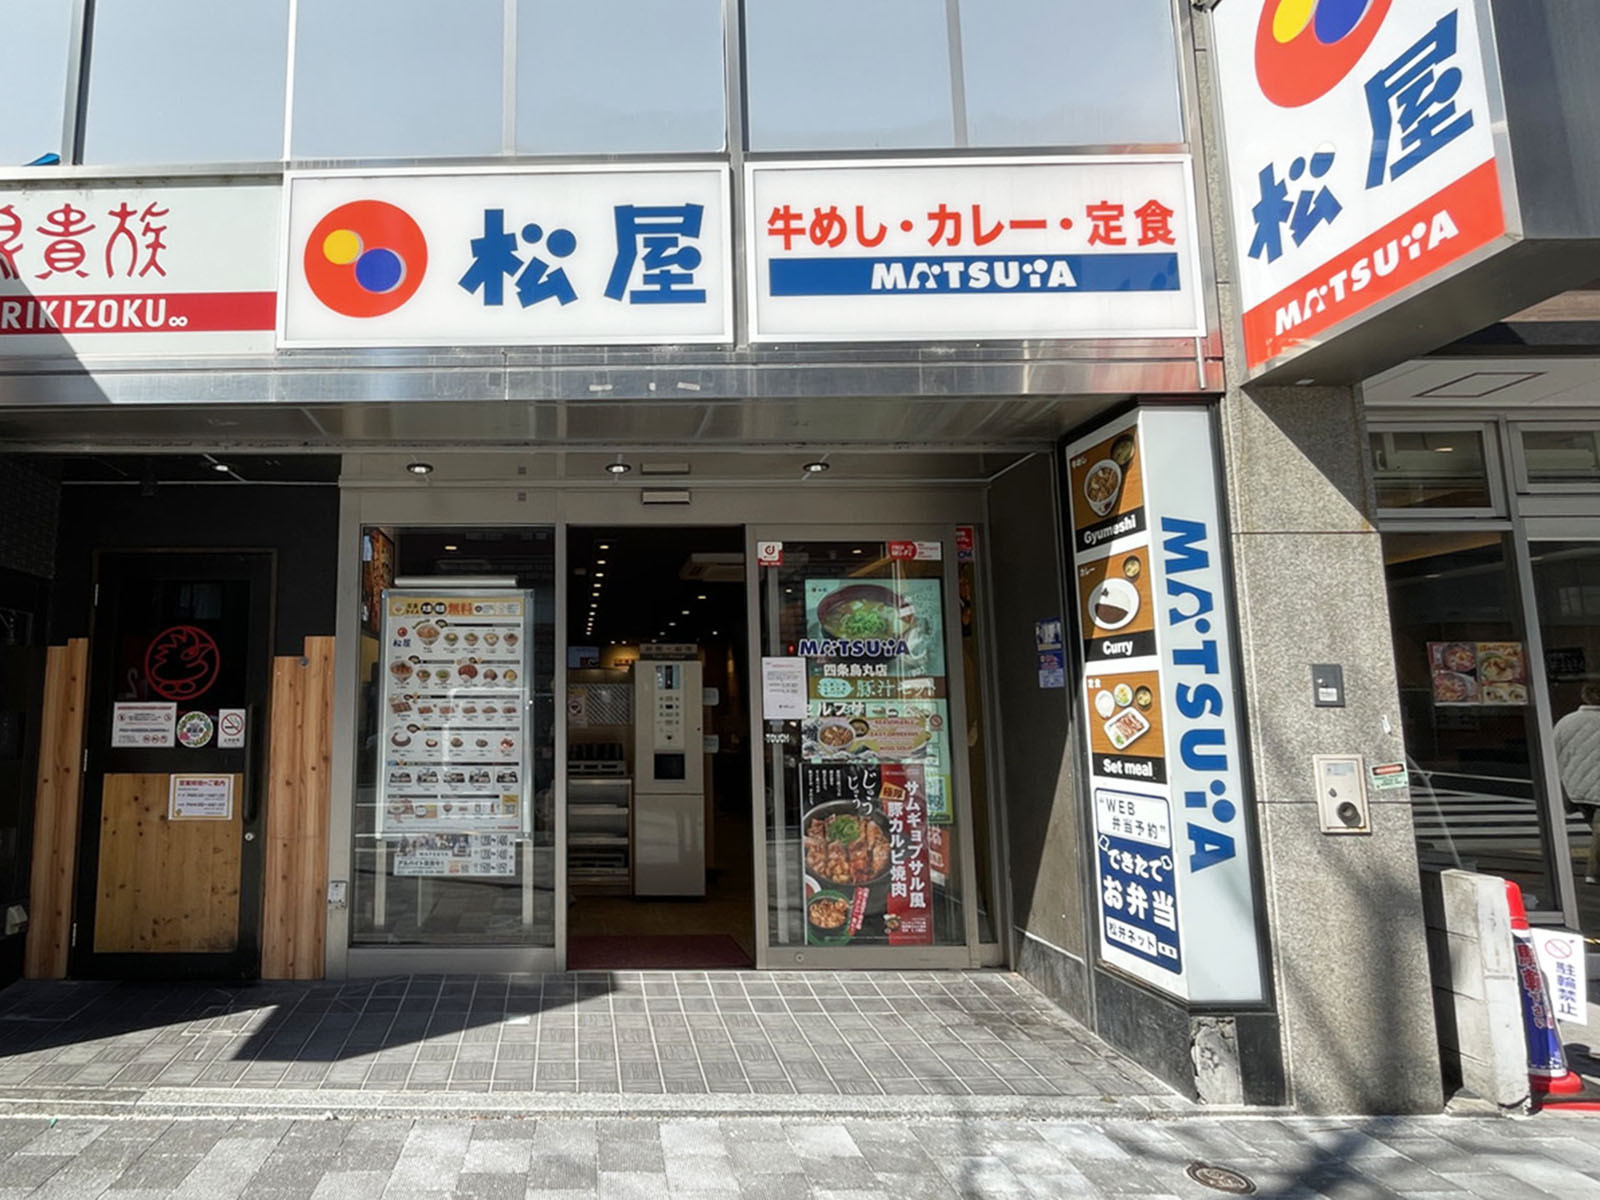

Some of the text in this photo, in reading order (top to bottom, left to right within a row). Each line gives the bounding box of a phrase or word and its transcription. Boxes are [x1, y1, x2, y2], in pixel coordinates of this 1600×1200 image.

[1247, 8, 1474, 264] 松屋
[767, 199, 1176, 250] 牛めし・カレー・定食
[458, 203, 706, 308] 松屋
[871, 258, 1077, 290] MATSUYA
[1274, 209, 1459, 337] MATSUYA
[1084, 514, 1136, 545] Gyumeshi
[798, 638, 910, 656] MATSUYA
[1102, 641, 1134, 656] Curry
[1160, 516, 1236, 874] MATSUYA
[1103, 759, 1153, 777] Set meal
[887, 801, 907, 897] 豚カルビ焼肉
[1107, 849, 1163, 882] できたて
[1103, 874, 1176, 931] お弁当
